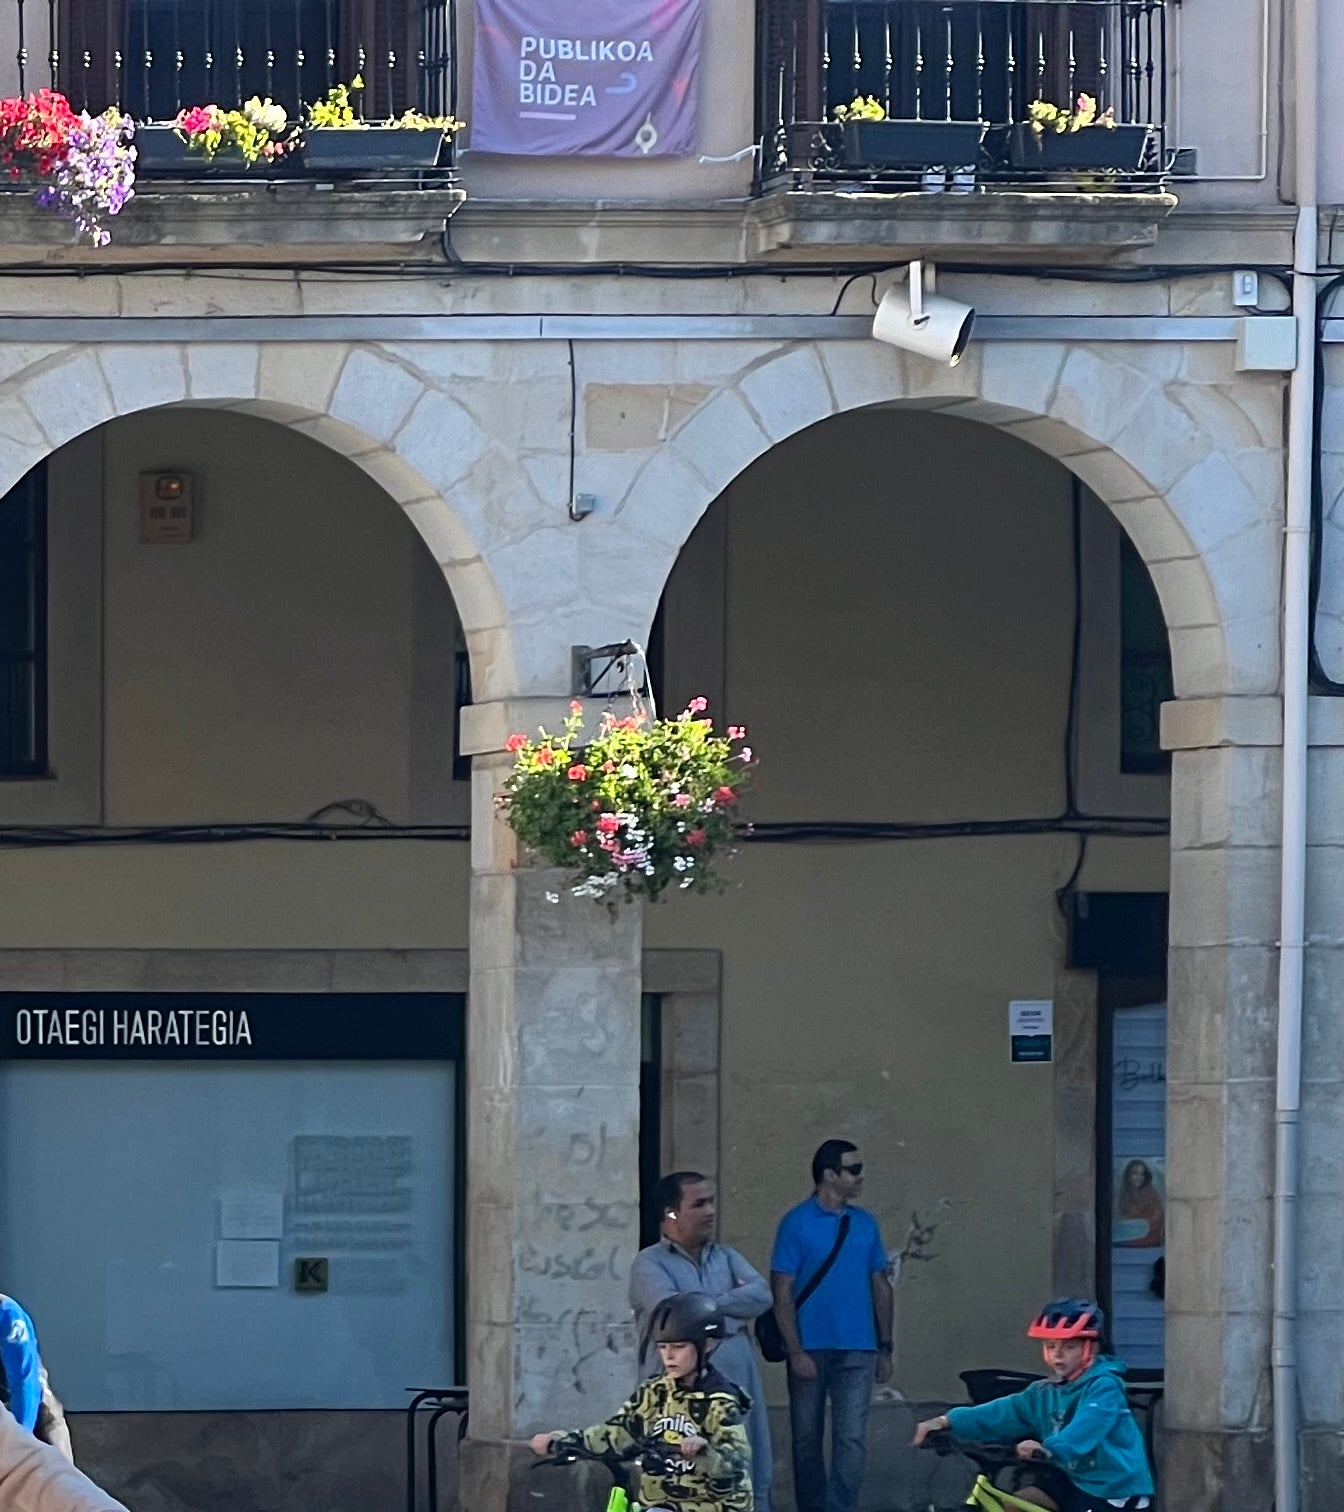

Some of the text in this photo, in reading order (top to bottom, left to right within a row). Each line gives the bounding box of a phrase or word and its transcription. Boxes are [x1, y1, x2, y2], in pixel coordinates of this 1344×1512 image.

[520, 36, 654, 62] PUBLIKOA
[519, 59, 556, 82] DA
[519, 82, 597, 107] BIDEA
[15, 1008, 253, 1046] OTAEGI HARATEGIA
